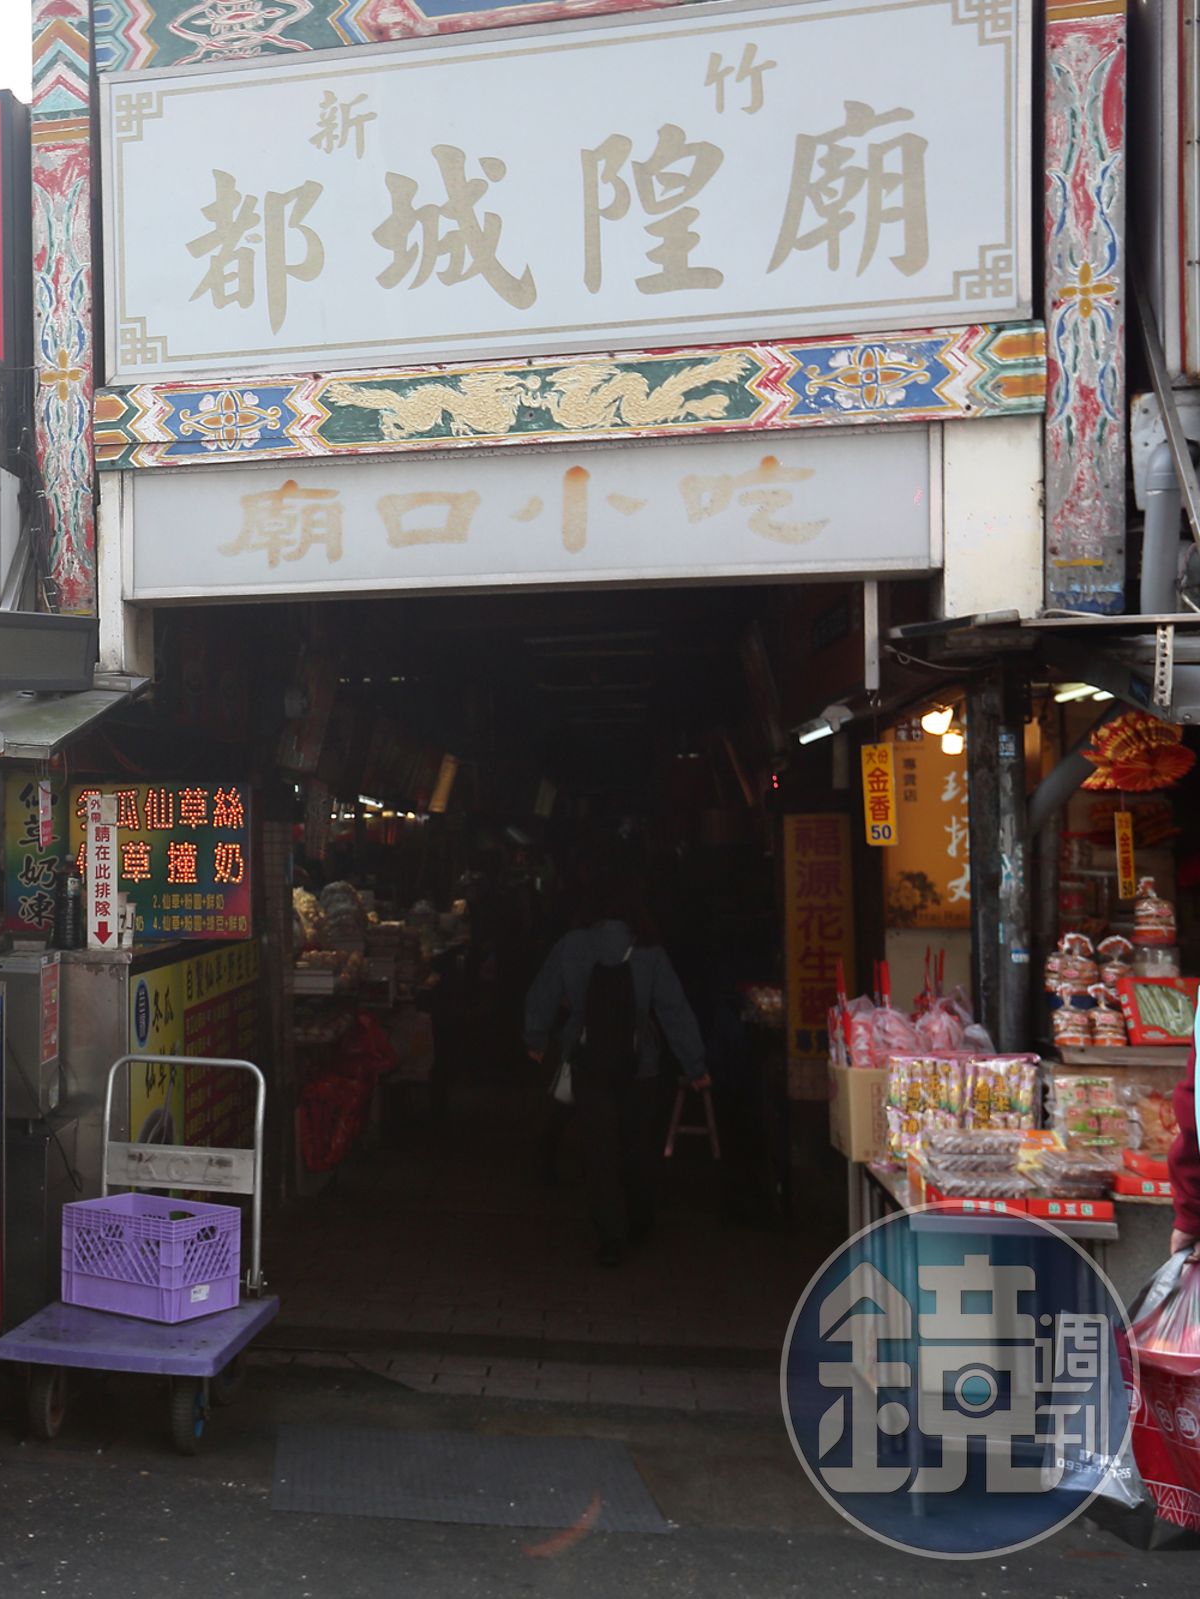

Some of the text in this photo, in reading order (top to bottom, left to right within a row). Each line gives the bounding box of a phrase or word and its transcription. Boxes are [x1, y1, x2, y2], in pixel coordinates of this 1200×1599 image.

[184, 100, 930, 336] 都城隍廟
[218, 455, 831, 568] 廟口小吃
[94, 825, 111, 918] 請在此排隊
[870, 825, 892, 840] 50
